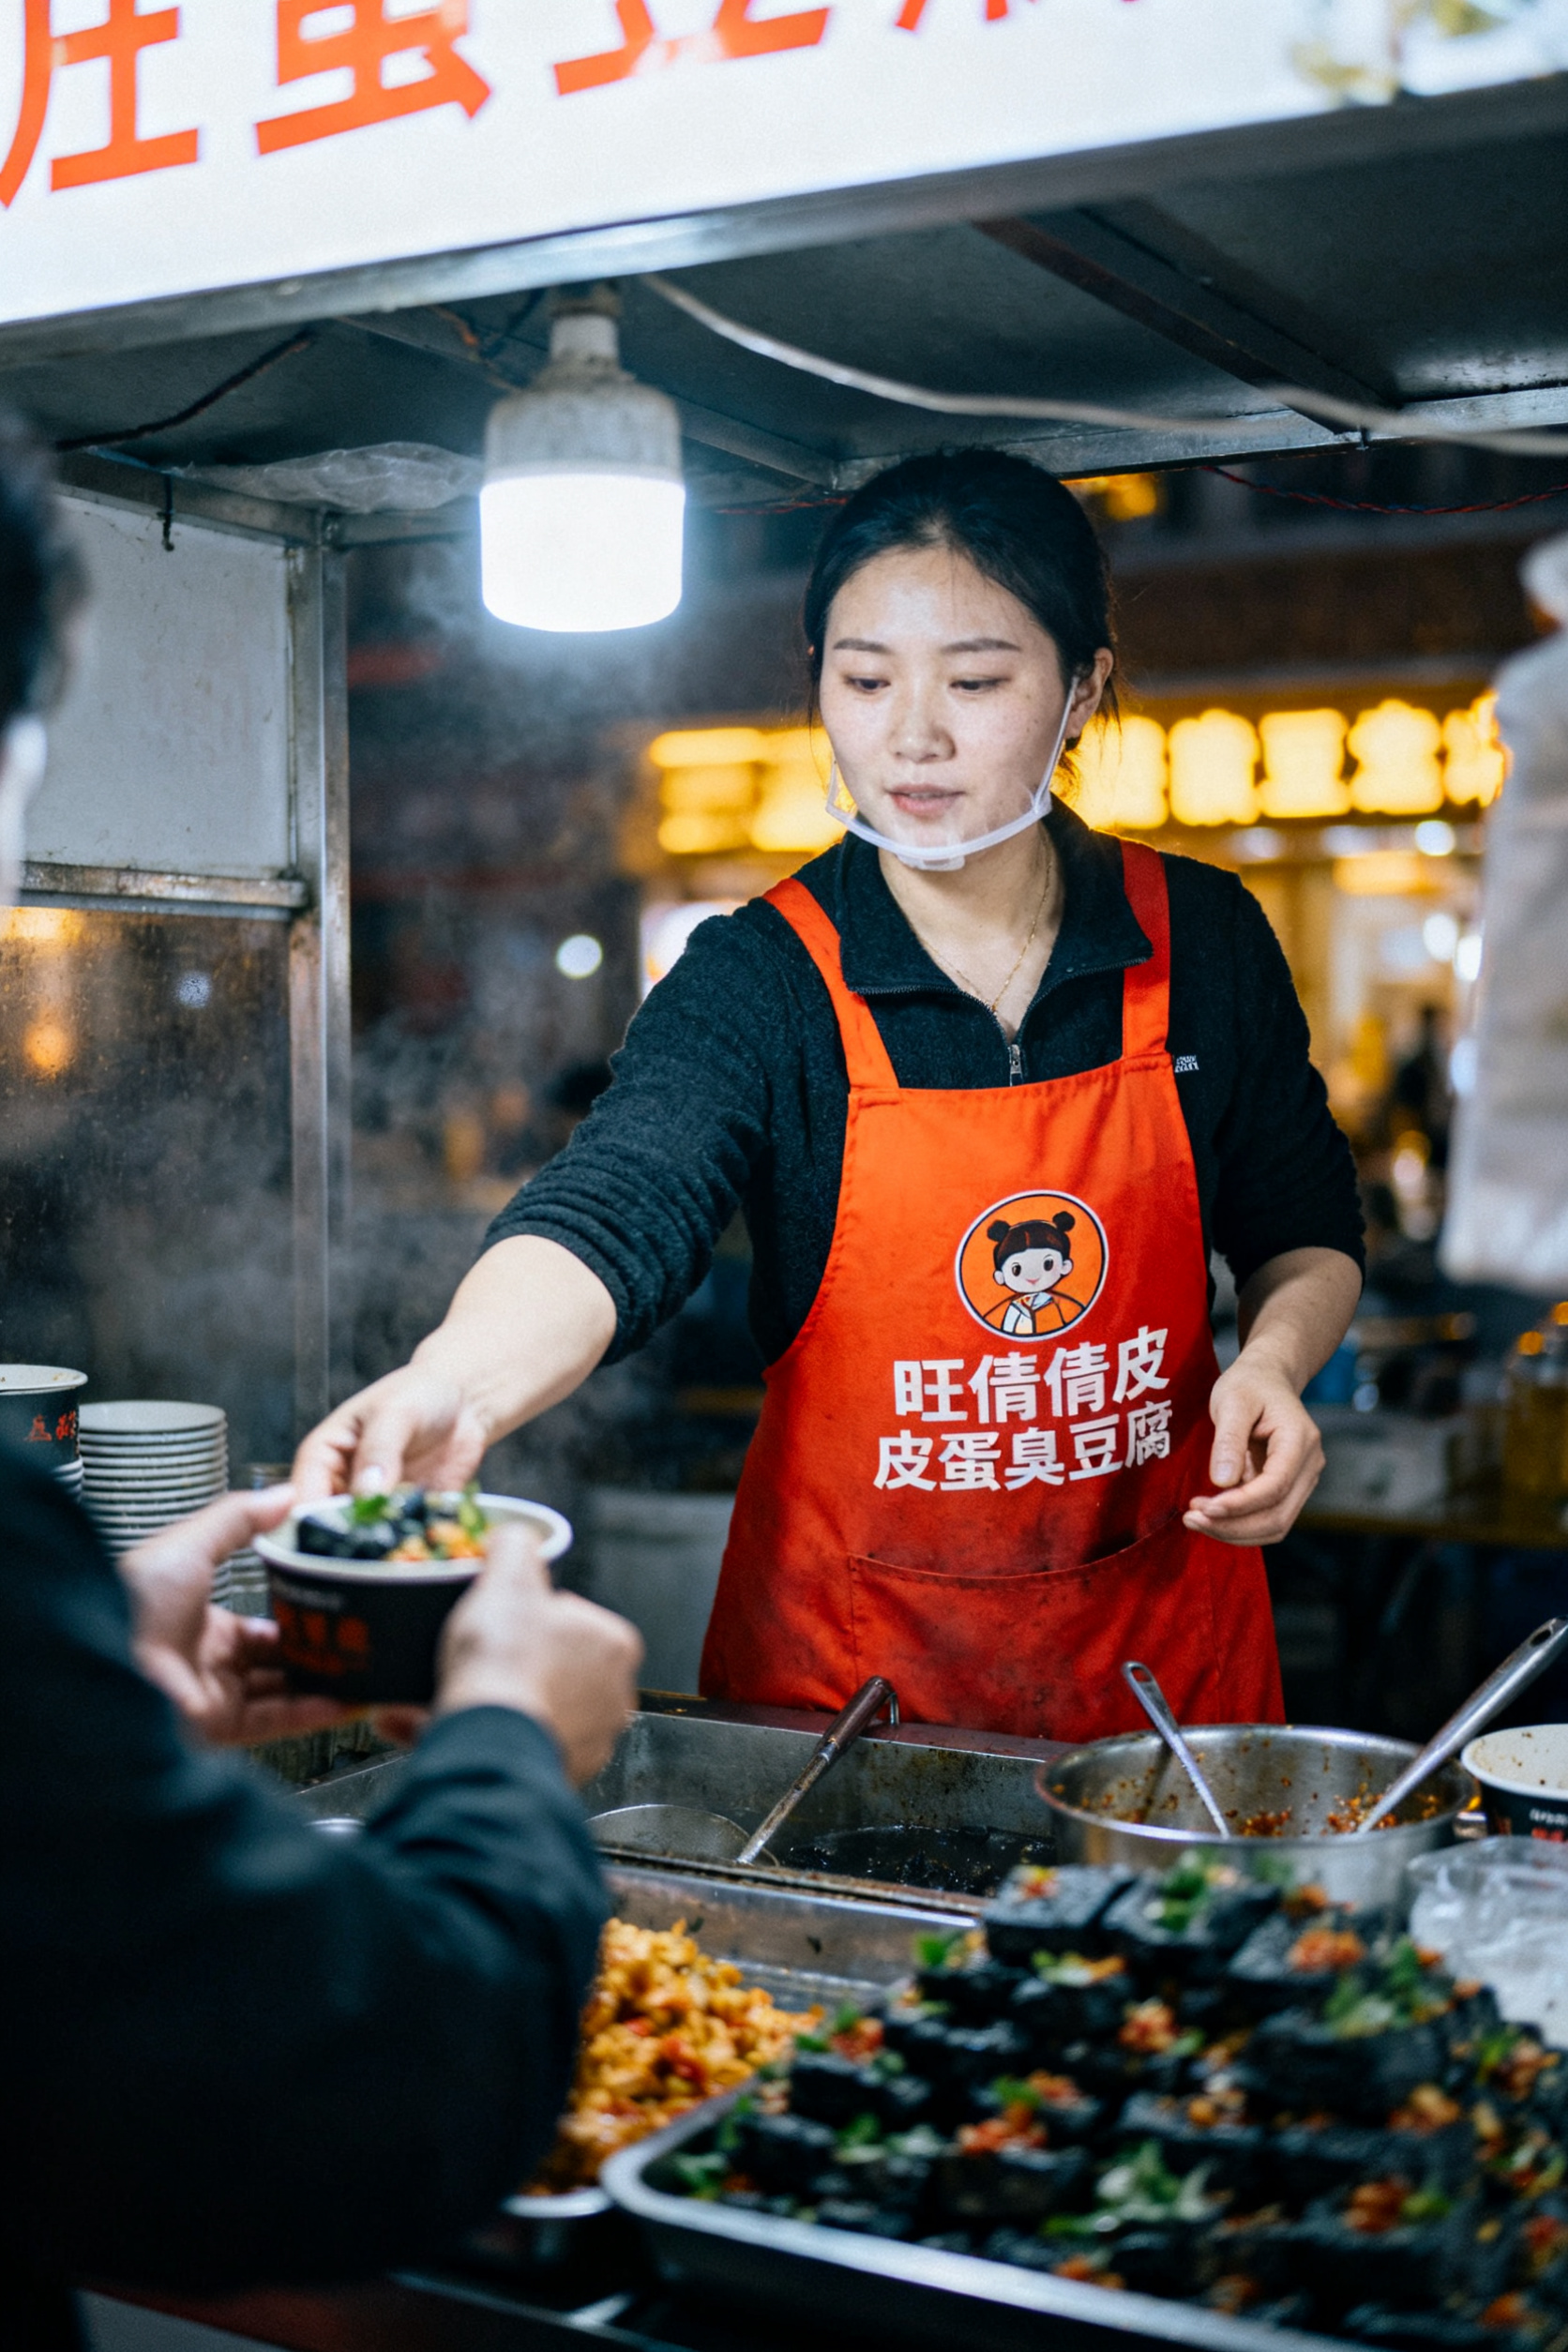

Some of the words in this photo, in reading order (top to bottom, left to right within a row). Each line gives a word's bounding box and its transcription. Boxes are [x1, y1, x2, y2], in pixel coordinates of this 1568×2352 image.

[894, 1325, 1170, 1424] 旺倩倩皮
[873, 1399, 1172, 1491] 皮蛋臭豆腐
